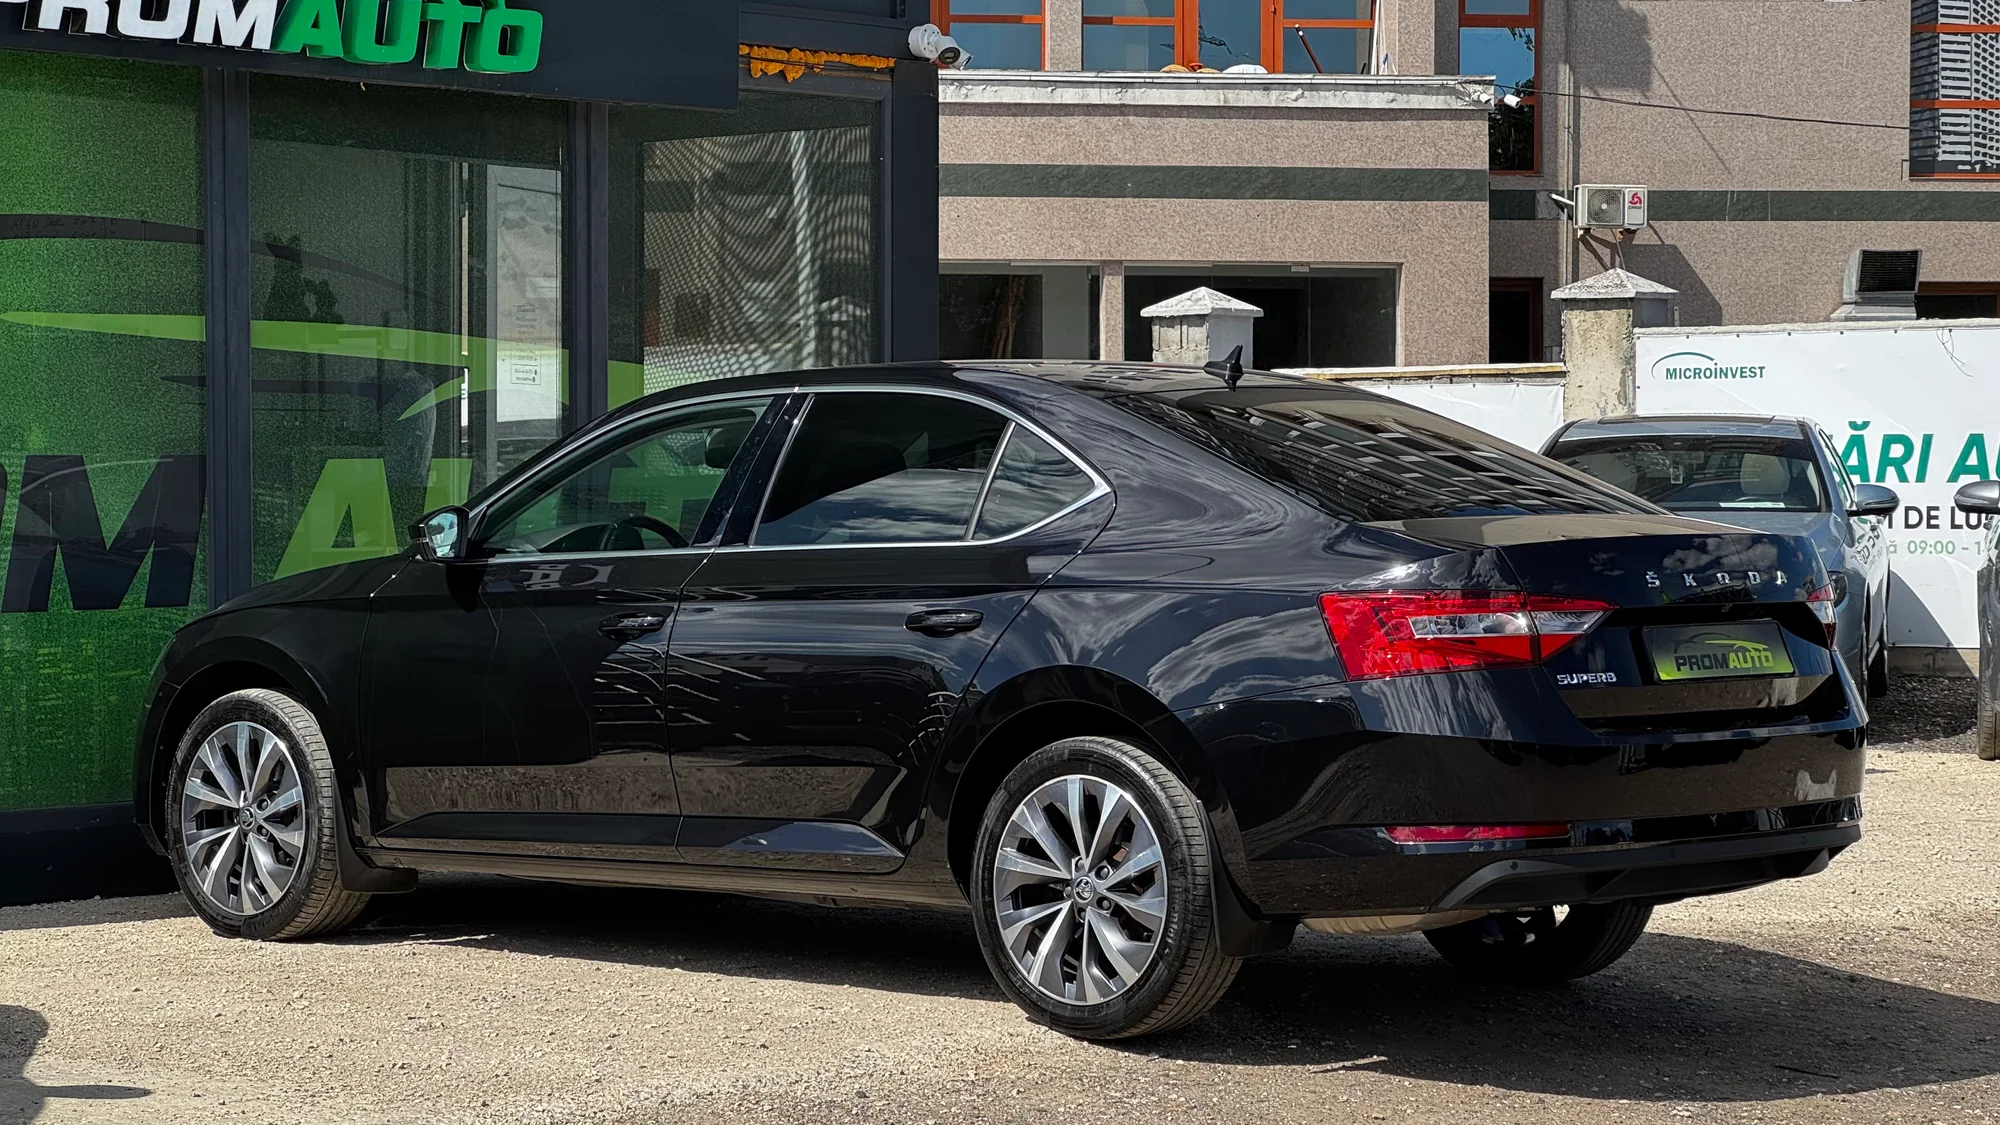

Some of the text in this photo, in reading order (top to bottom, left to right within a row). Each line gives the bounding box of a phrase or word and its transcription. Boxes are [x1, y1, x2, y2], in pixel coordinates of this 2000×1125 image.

[1829, 421, 1934, 483] ĂRI
[1904, 505, 1940, 529] DE
[1950, 505, 1989, 530] LU
[1907, 540, 1956, 555] 09:00
[1646, 571, 1788, 588] ŠKODA
[1674, 651, 1775, 672] PROMAUTO
[1556, 672, 1617, 685] SUPERB
